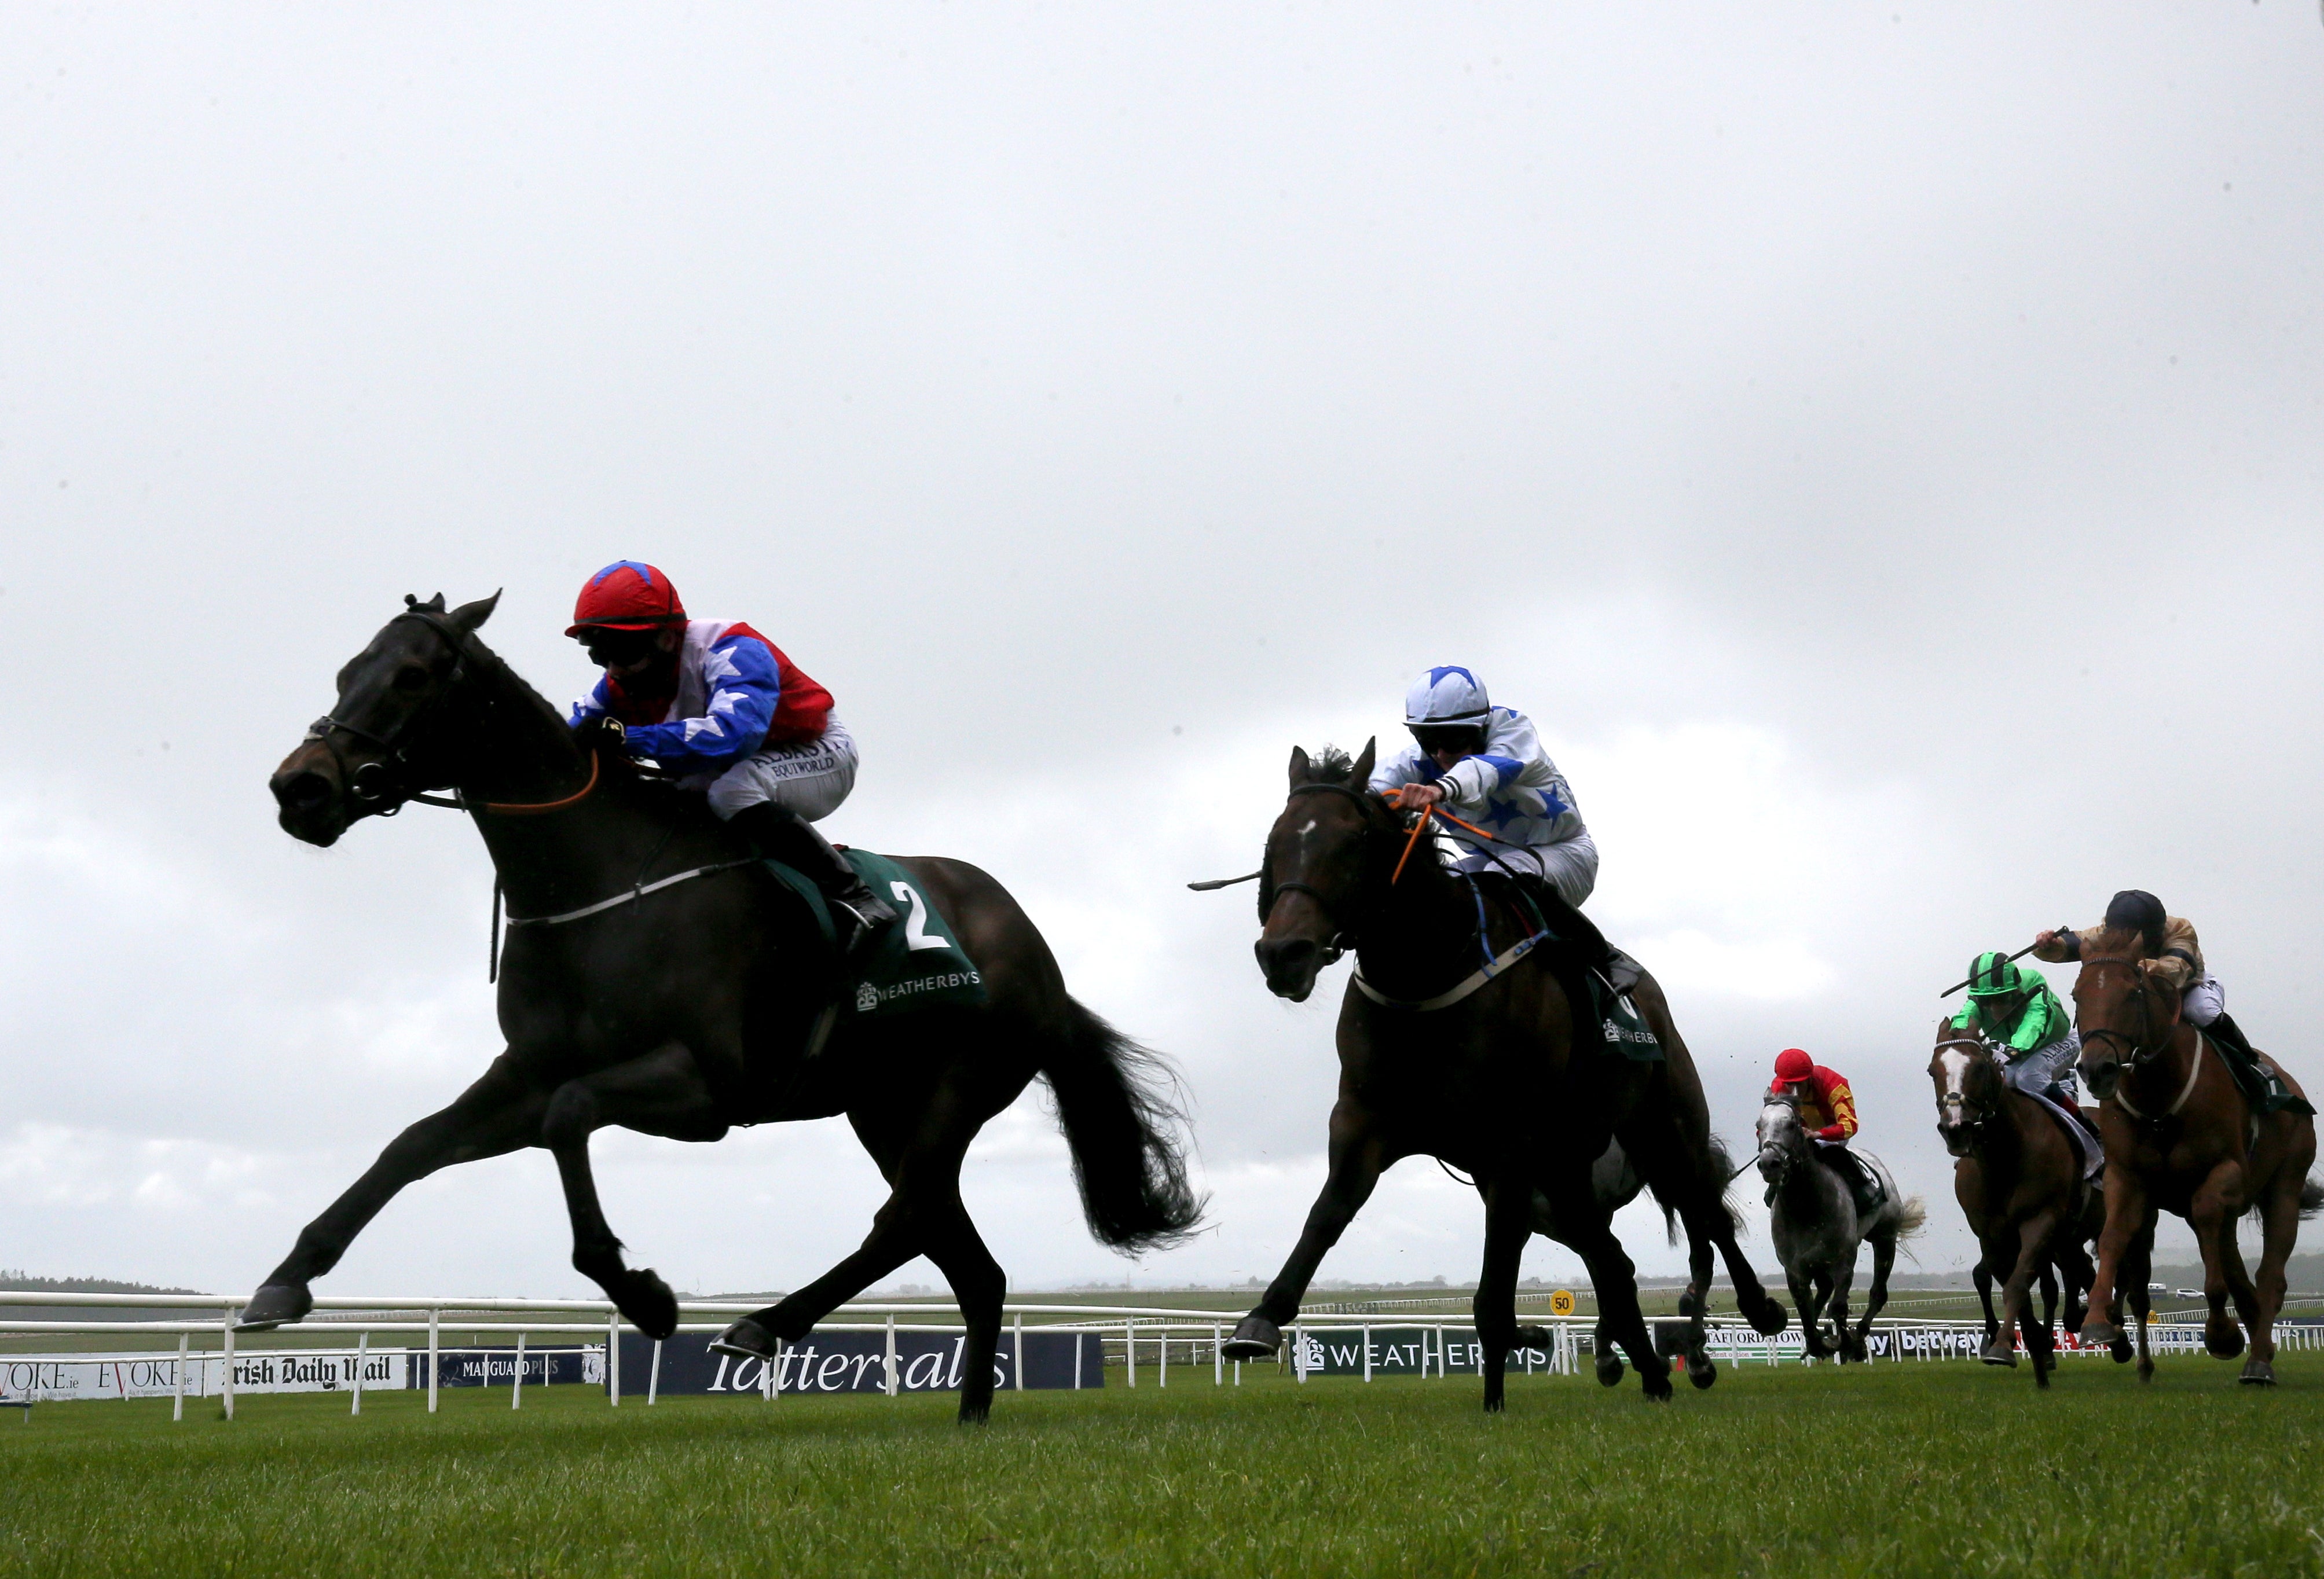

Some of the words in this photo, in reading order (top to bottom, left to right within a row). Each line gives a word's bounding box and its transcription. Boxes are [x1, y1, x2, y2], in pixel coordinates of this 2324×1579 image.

[771, 757, 834, 777] EQUIWORLD
[890, 881, 951, 951] 2
[877, 971, 981, 1002] WEATHERBYS
[1555, 1297, 1569, 1310] 50
[1901, 1331, 1984, 1354] betway
[706, 1335, 1009, 1391] Tattersals
[1330, 1343, 1546, 1367] WEATHERYS
[222, 1358, 274, 1386] rish
[281, 1356, 337, 1391] Daily
[463, 1361, 530, 1377] MANGUAD
